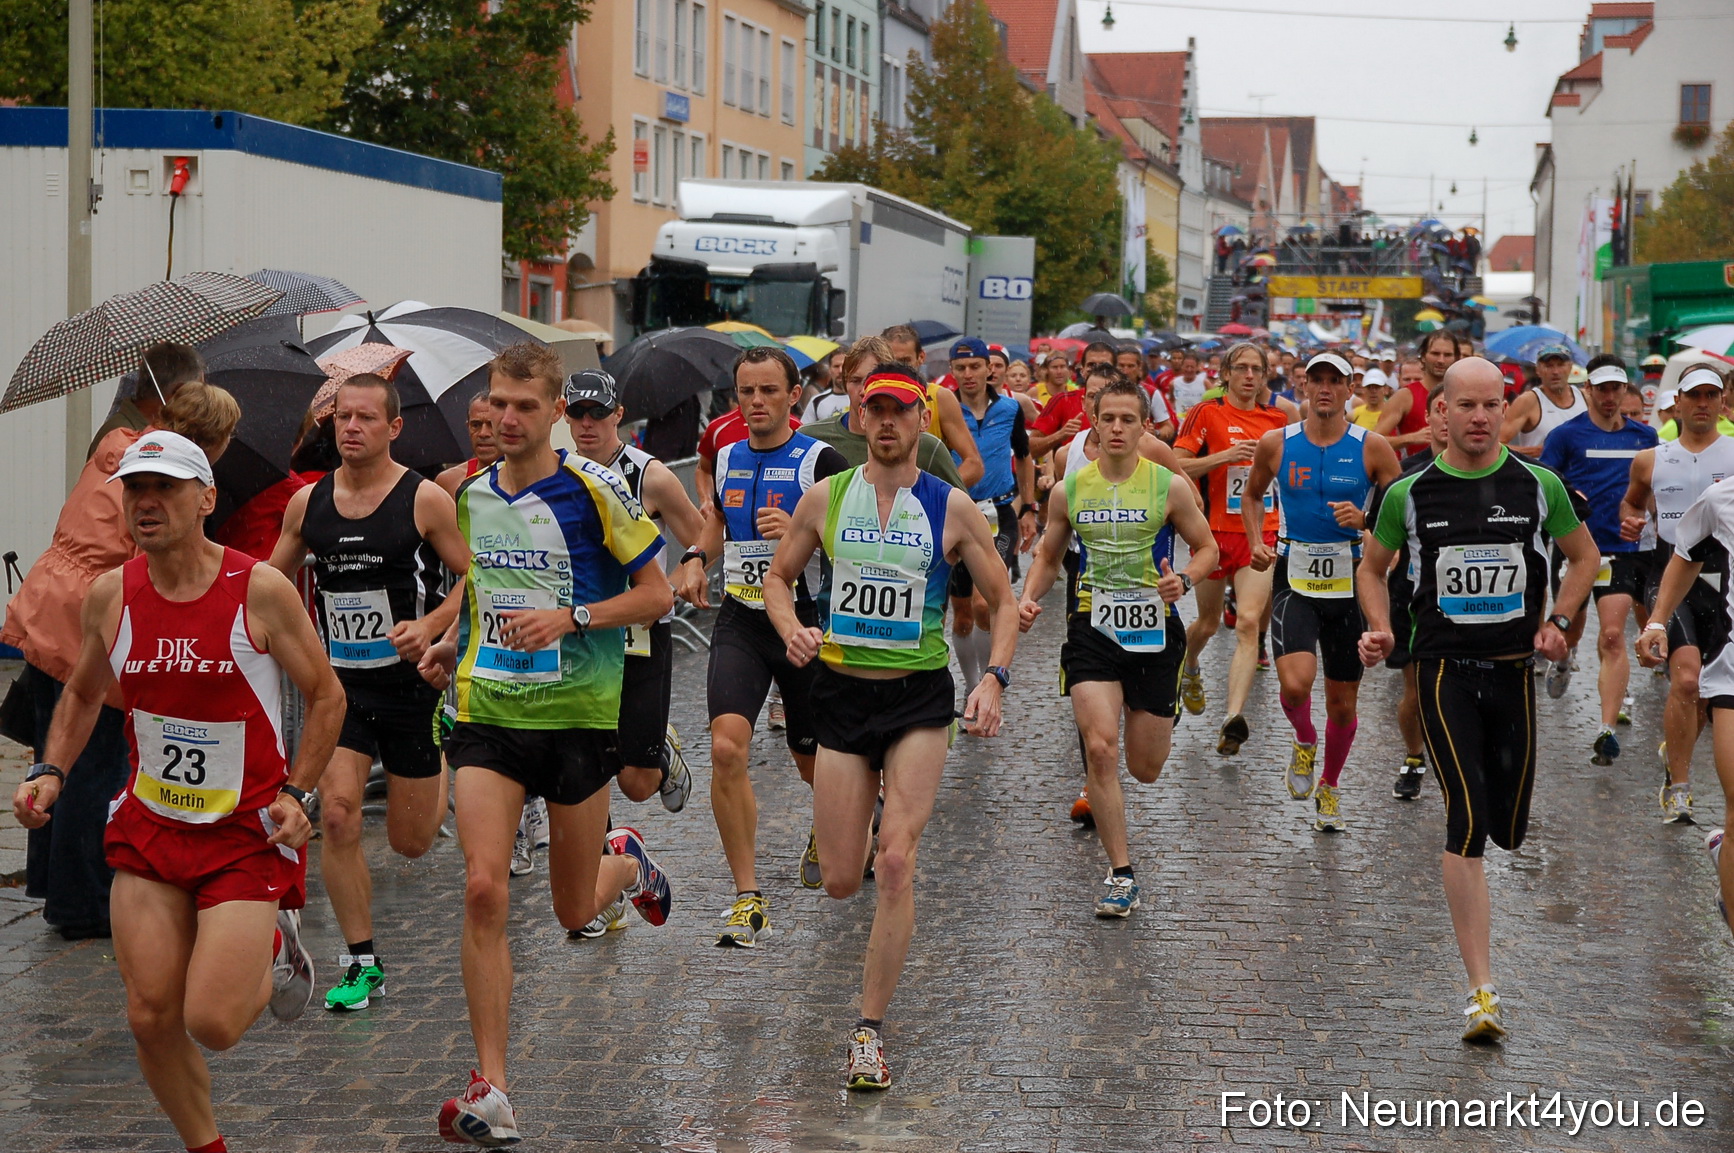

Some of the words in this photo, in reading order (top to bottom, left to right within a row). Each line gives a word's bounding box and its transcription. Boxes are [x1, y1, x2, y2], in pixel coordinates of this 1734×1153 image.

[695, 236, 777, 255] BOCK
[1317, 280, 1370, 293] START
[581, 461, 643, 521] BOCK
[1081, 498, 1123, 509] TEAM
[847, 515, 899, 529] TEAM
[1076, 509, 1148, 524] BOCK
[477, 533, 520, 549] TEAM
[842, 528, 922, 547] BOCK
[339, 553, 384, 563] Marathon
[476, 550, 550, 570] BOCK
[1464, 549, 1500, 558] BOCK
[861, 566, 898, 578] BOCK
[1307, 558, 1334, 578] 40
[1306, 582, 1333, 591] Stefan
[1446, 565, 1519, 595] 3077
[491, 594, 526, 604] BOCK
[840, 581, 913, 618] 2001
[1462, 601, 1504, 612] Jochen
[1098, 604, 1158, 629] 2083
[330, 611, 387, 640] 3122
[855, 622, 893, 637] Marco
[156, 638, 202, 666] DJK
[343, 646, 371, 658] Oliver
[493, 653, 534, 669] Michael
[163, 723, 208, 739] BOCK
[161, 744, 206, 785] 23
[160, 787, 205, 809] Martin
